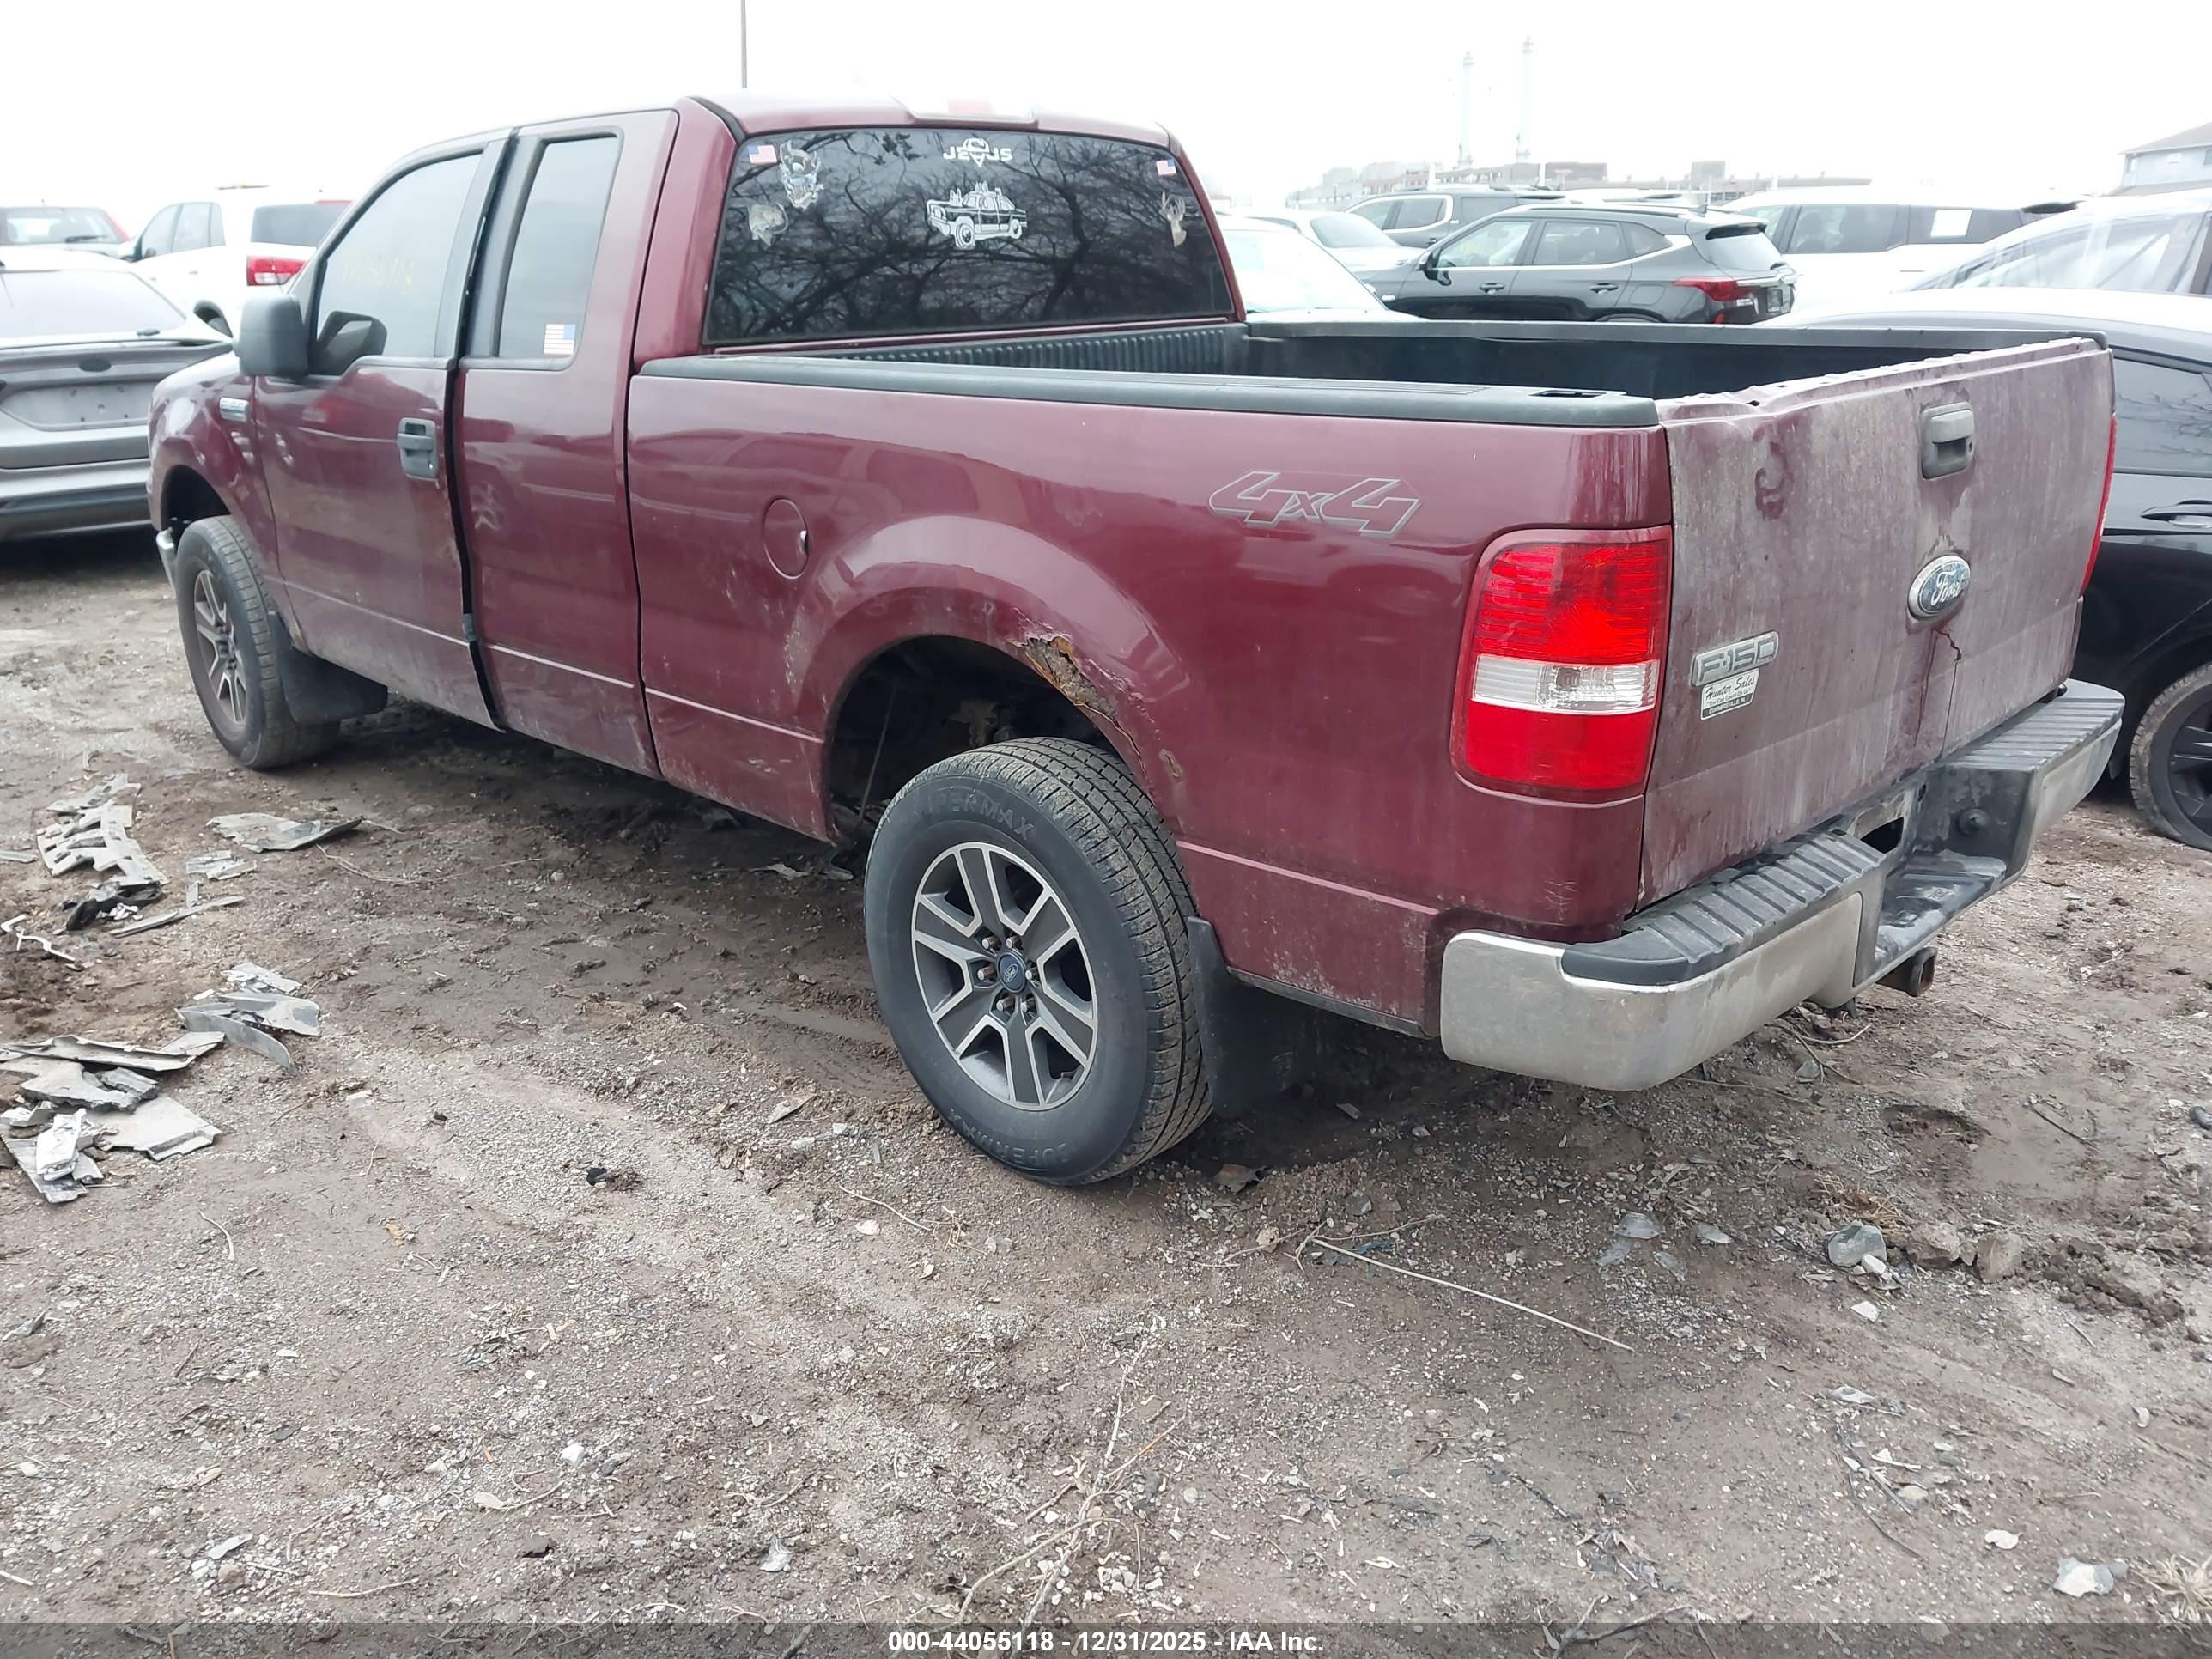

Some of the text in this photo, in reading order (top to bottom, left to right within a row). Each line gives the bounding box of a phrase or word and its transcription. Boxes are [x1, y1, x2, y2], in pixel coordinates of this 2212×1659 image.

[943, 137, 1013, 167] JESUS
[1208, 470, 1421, 536] 4x4
[1930, 569, 1966, 606] Ford
[1699, 637, 1777, 682] F-150
[1705, 676, 1755, 700] Hunter Sales
